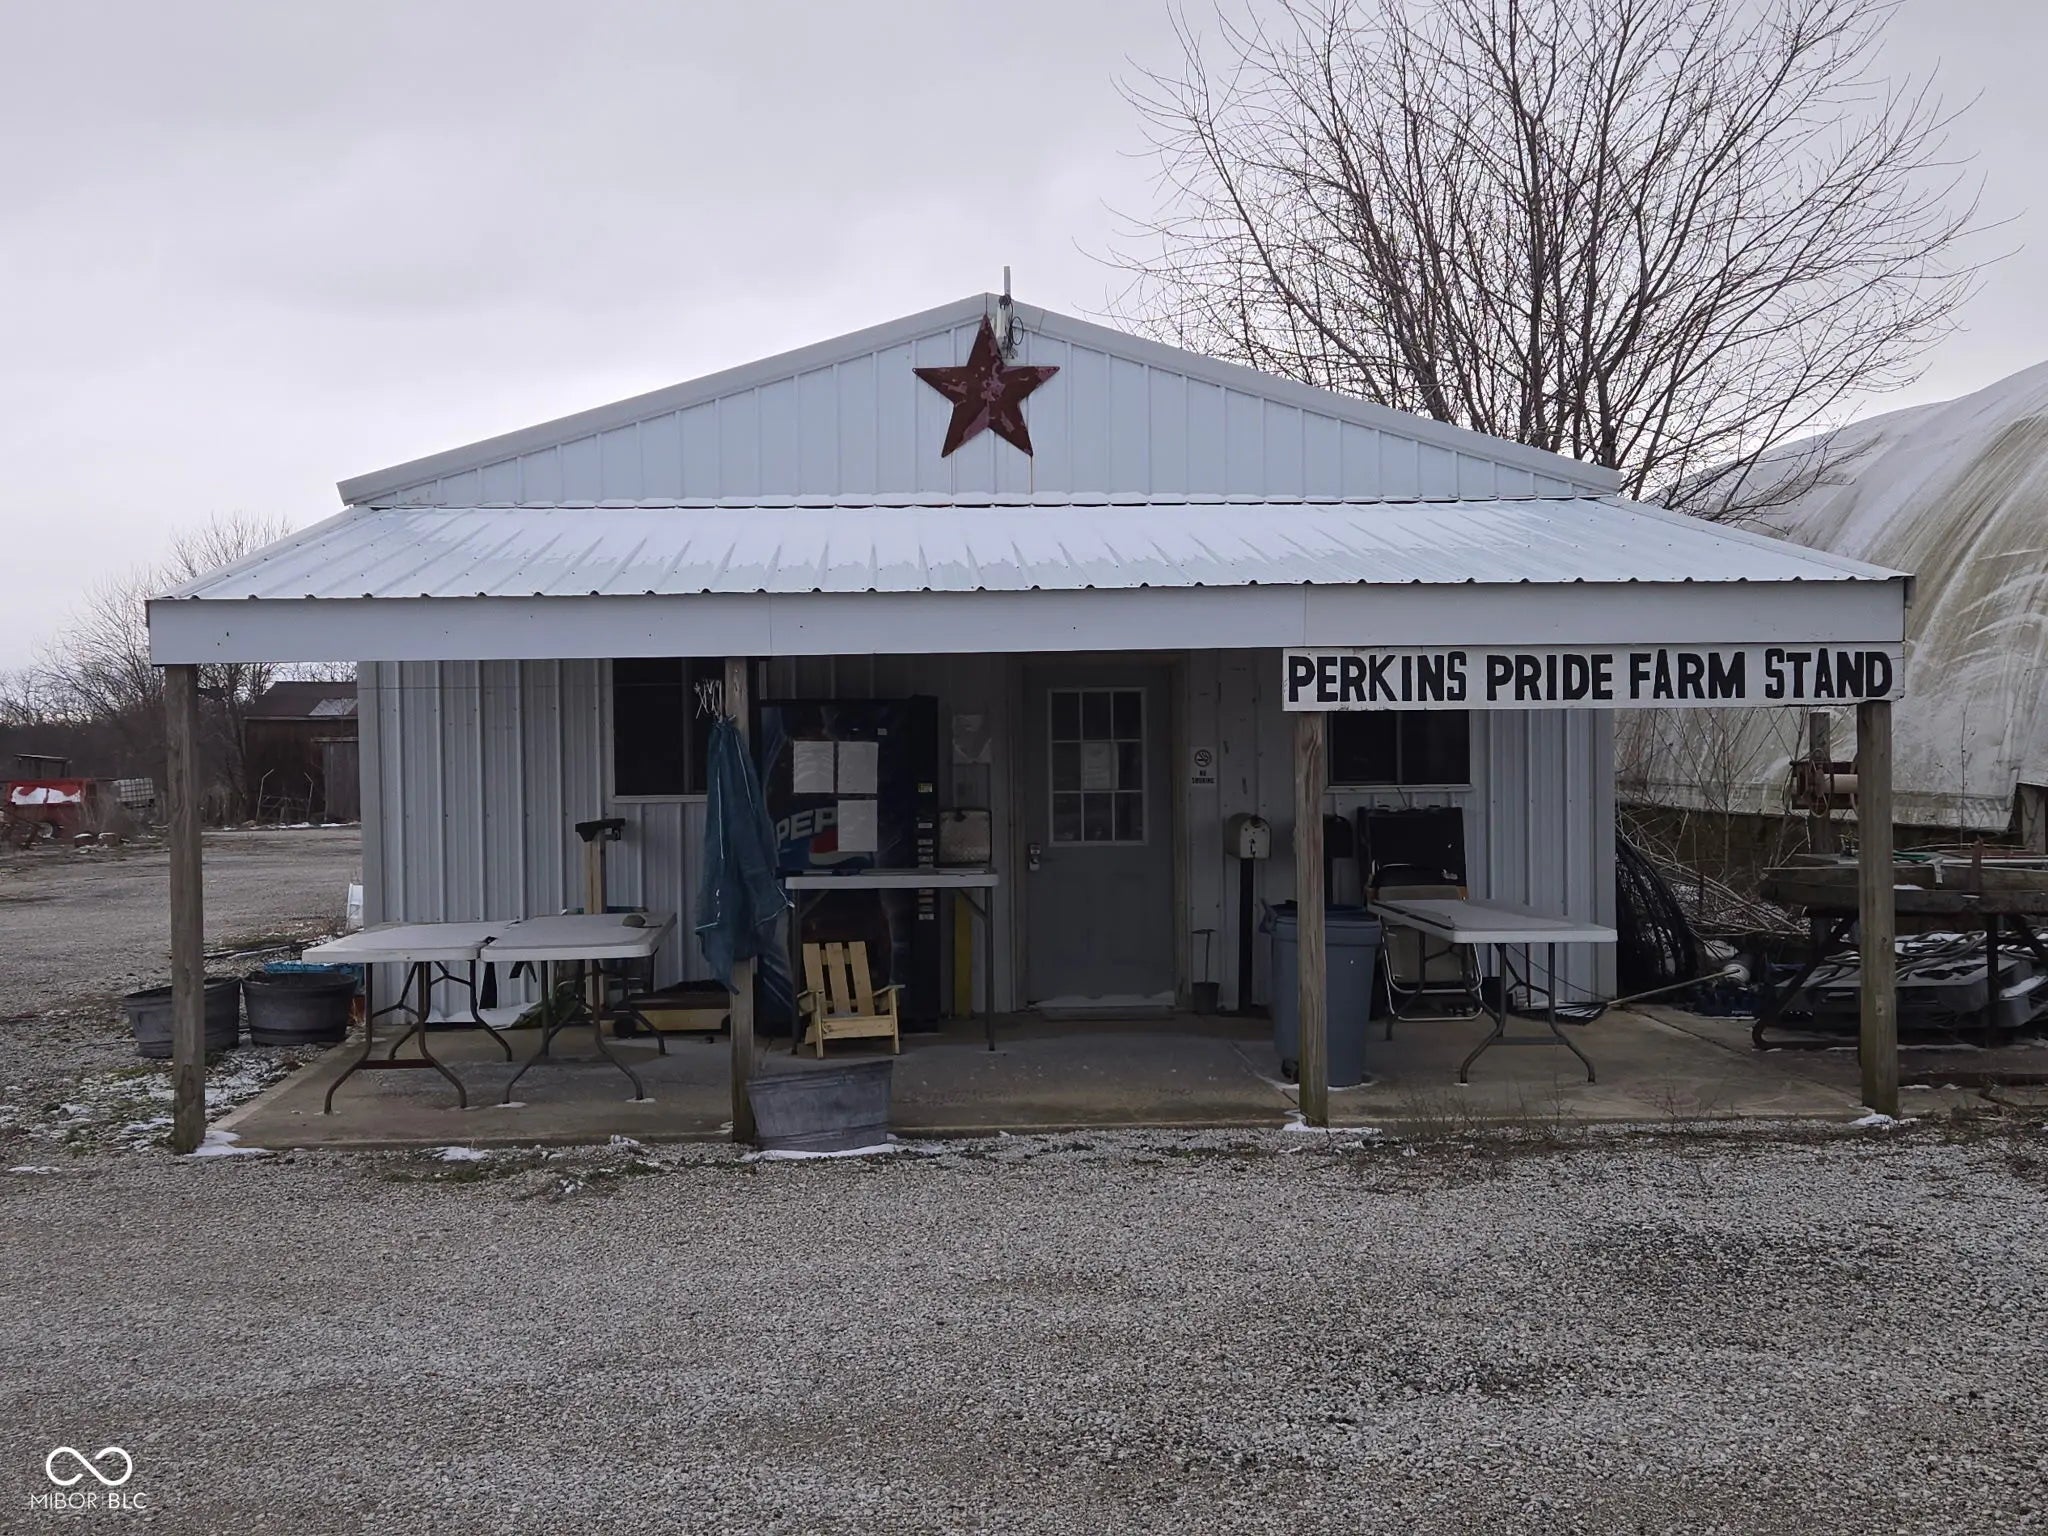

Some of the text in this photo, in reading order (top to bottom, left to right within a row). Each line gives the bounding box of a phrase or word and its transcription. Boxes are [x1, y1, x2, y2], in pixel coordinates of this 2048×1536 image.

[1288, 649, 1893, 702] PERKINS PRIDE FARM STAND
[776, 806, 838, 848] PEP
